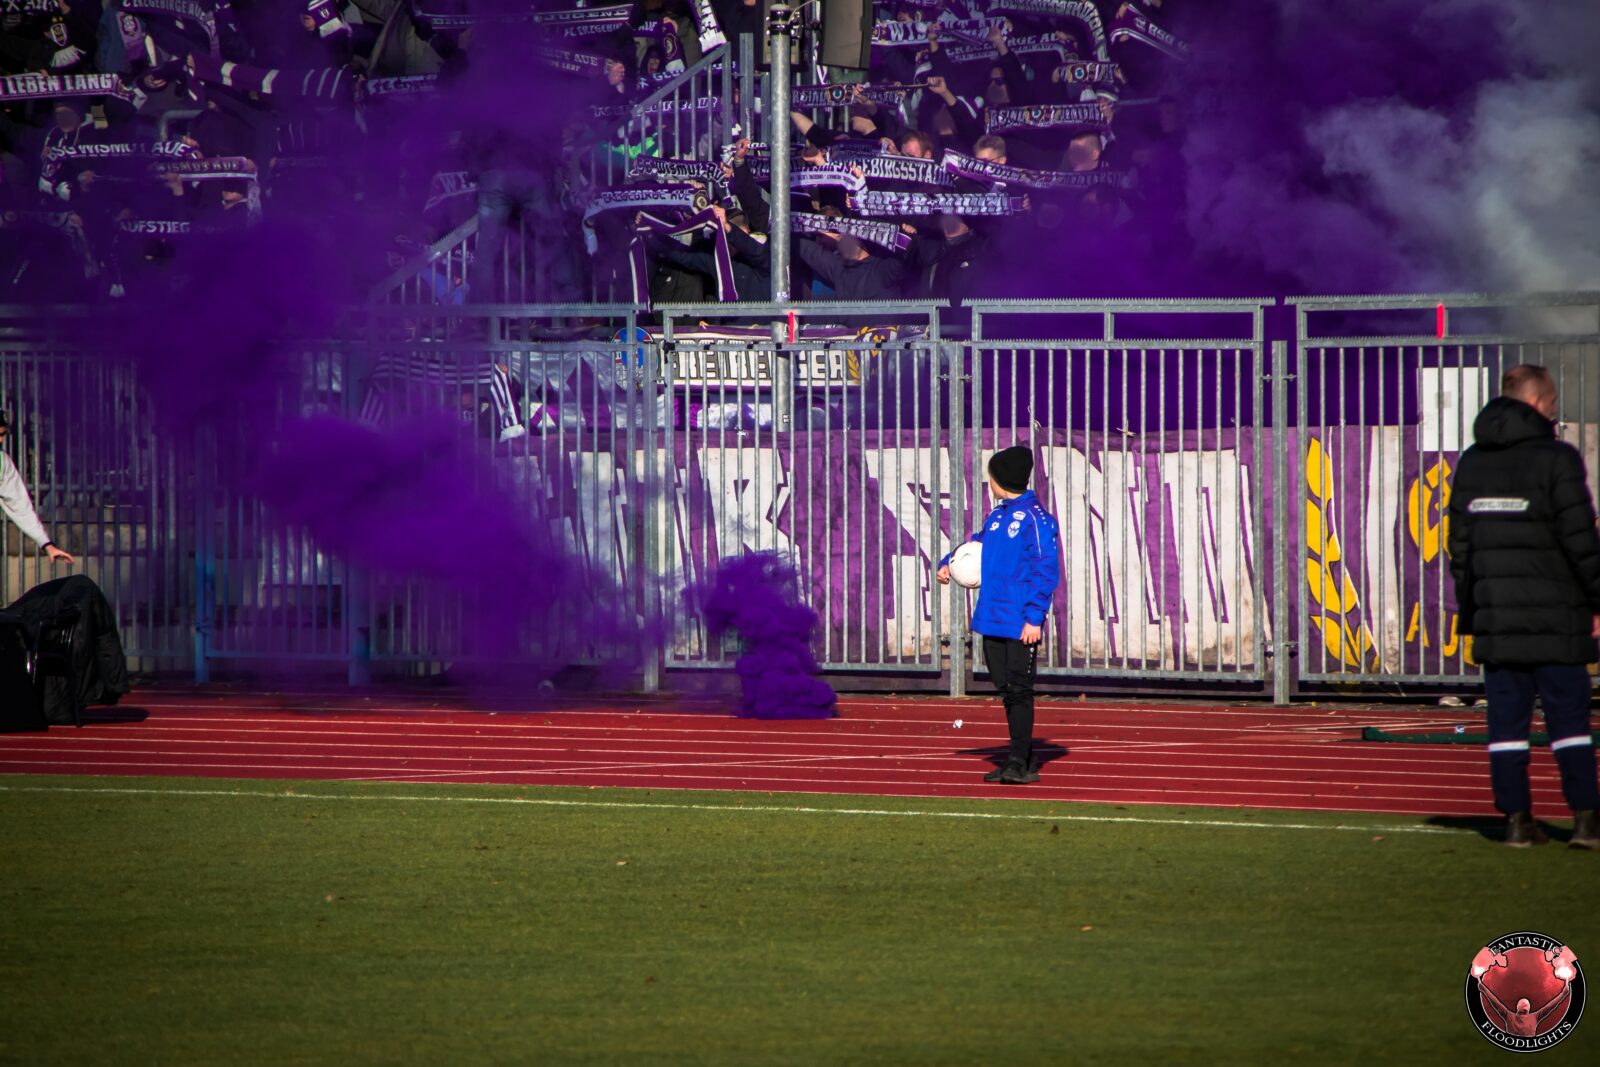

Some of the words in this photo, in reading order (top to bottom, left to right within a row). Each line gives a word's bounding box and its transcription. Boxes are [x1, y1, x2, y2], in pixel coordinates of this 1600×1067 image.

[7, 76, 59, 95] LEBEN
[151, 141, 190, 158] AUE
[119, 220, 191, 234] AUFSTIEG
[659, 338, 846, 379] FREIBEGER
[1405, 602, 1479, 667] AU
